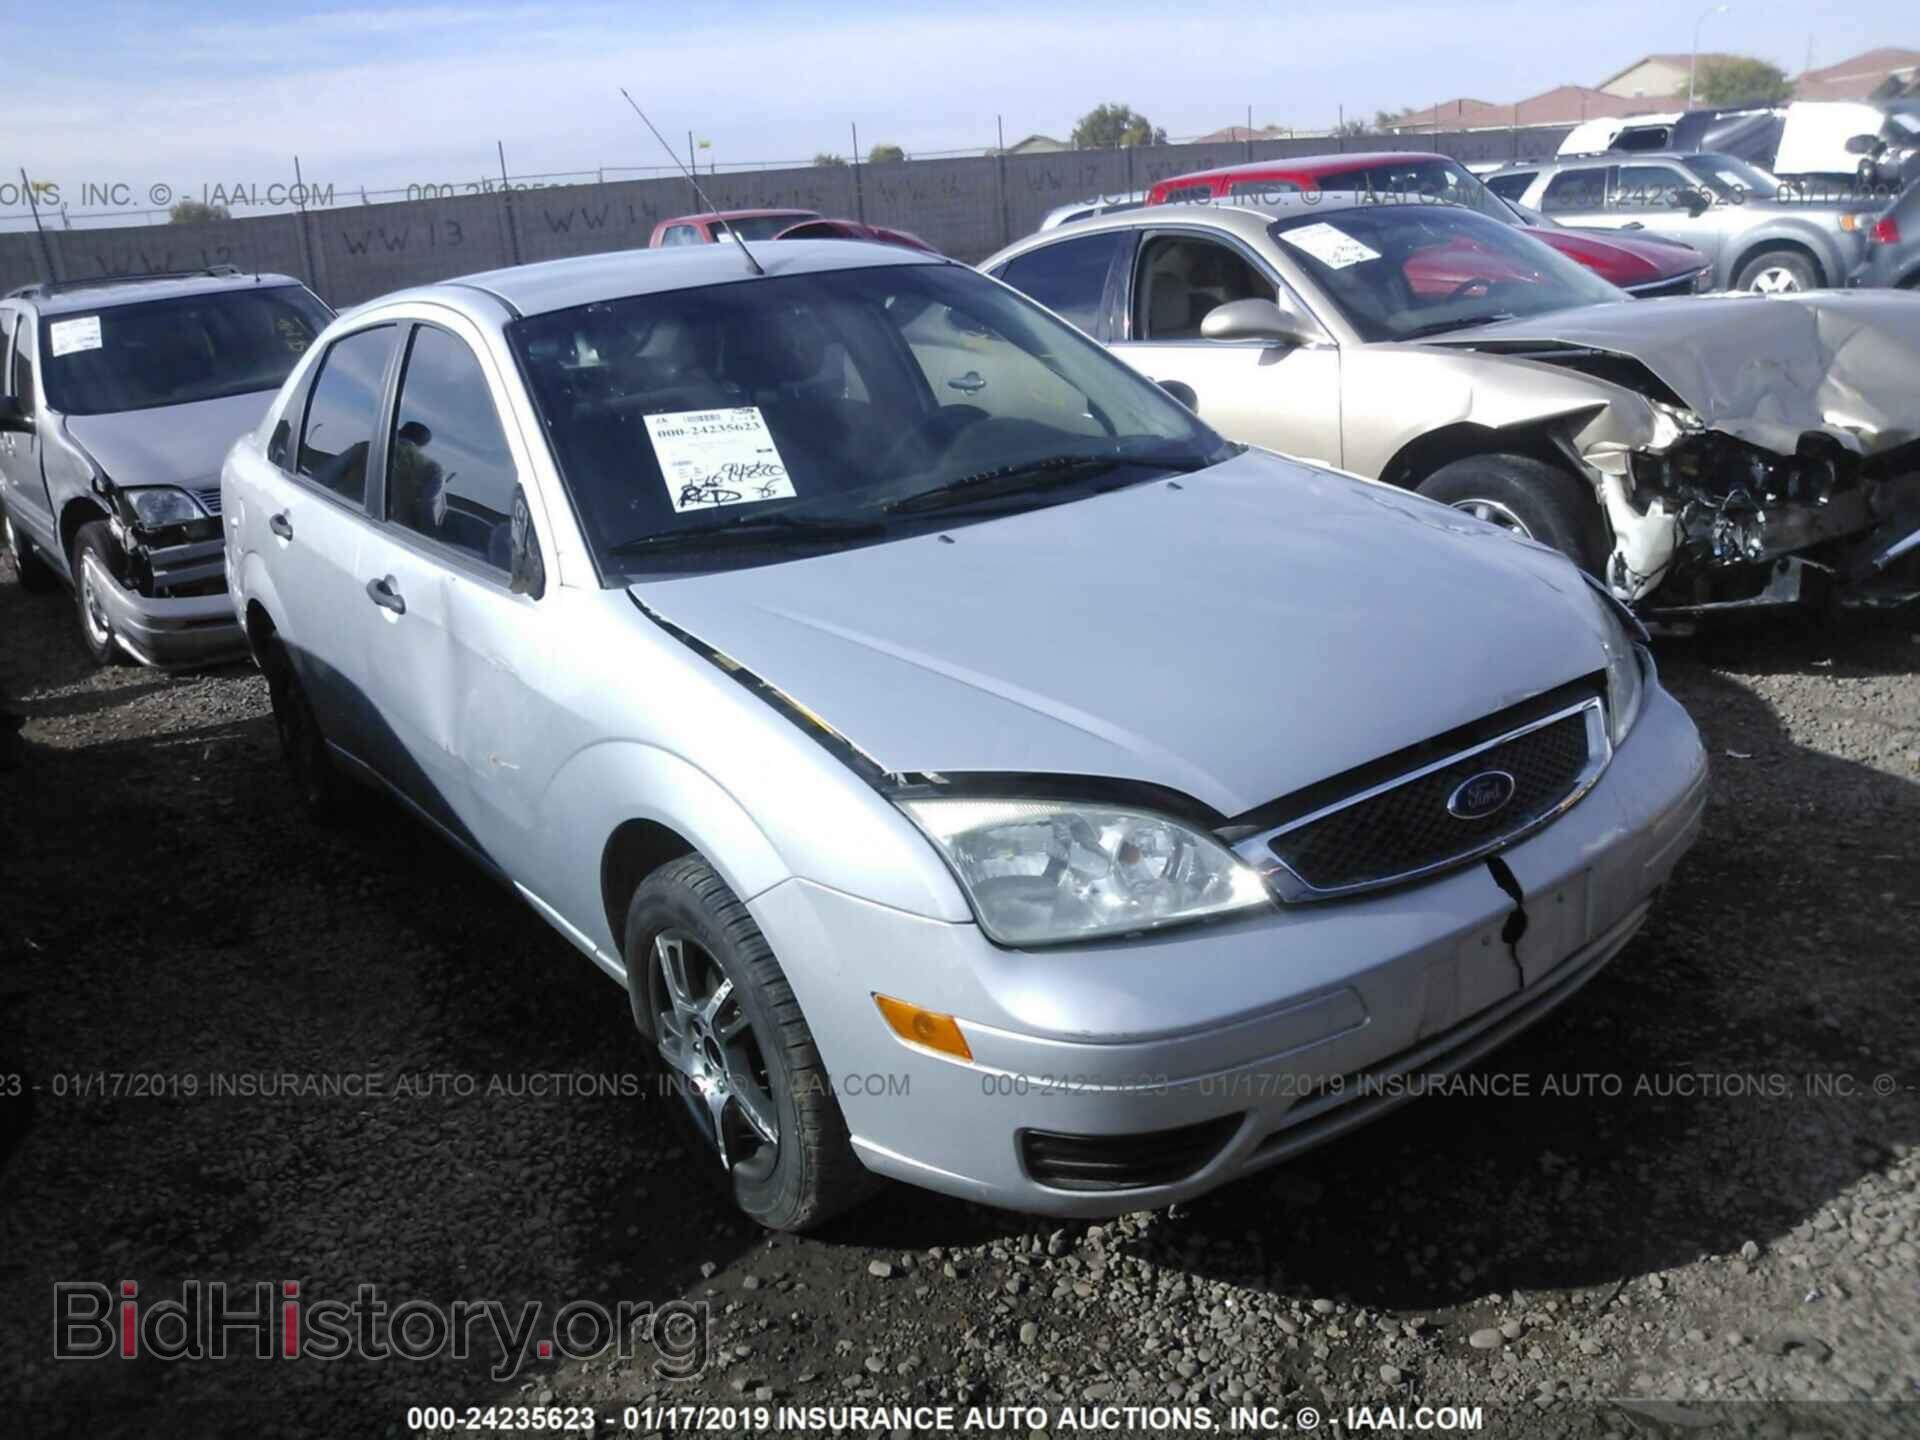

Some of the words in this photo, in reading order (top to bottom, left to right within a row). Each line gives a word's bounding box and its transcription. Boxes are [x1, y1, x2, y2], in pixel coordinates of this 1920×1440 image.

[544, 204, 609, 233] WW
[341, 223, 410, 256] WW
[428, 221, 464, 247] 13
